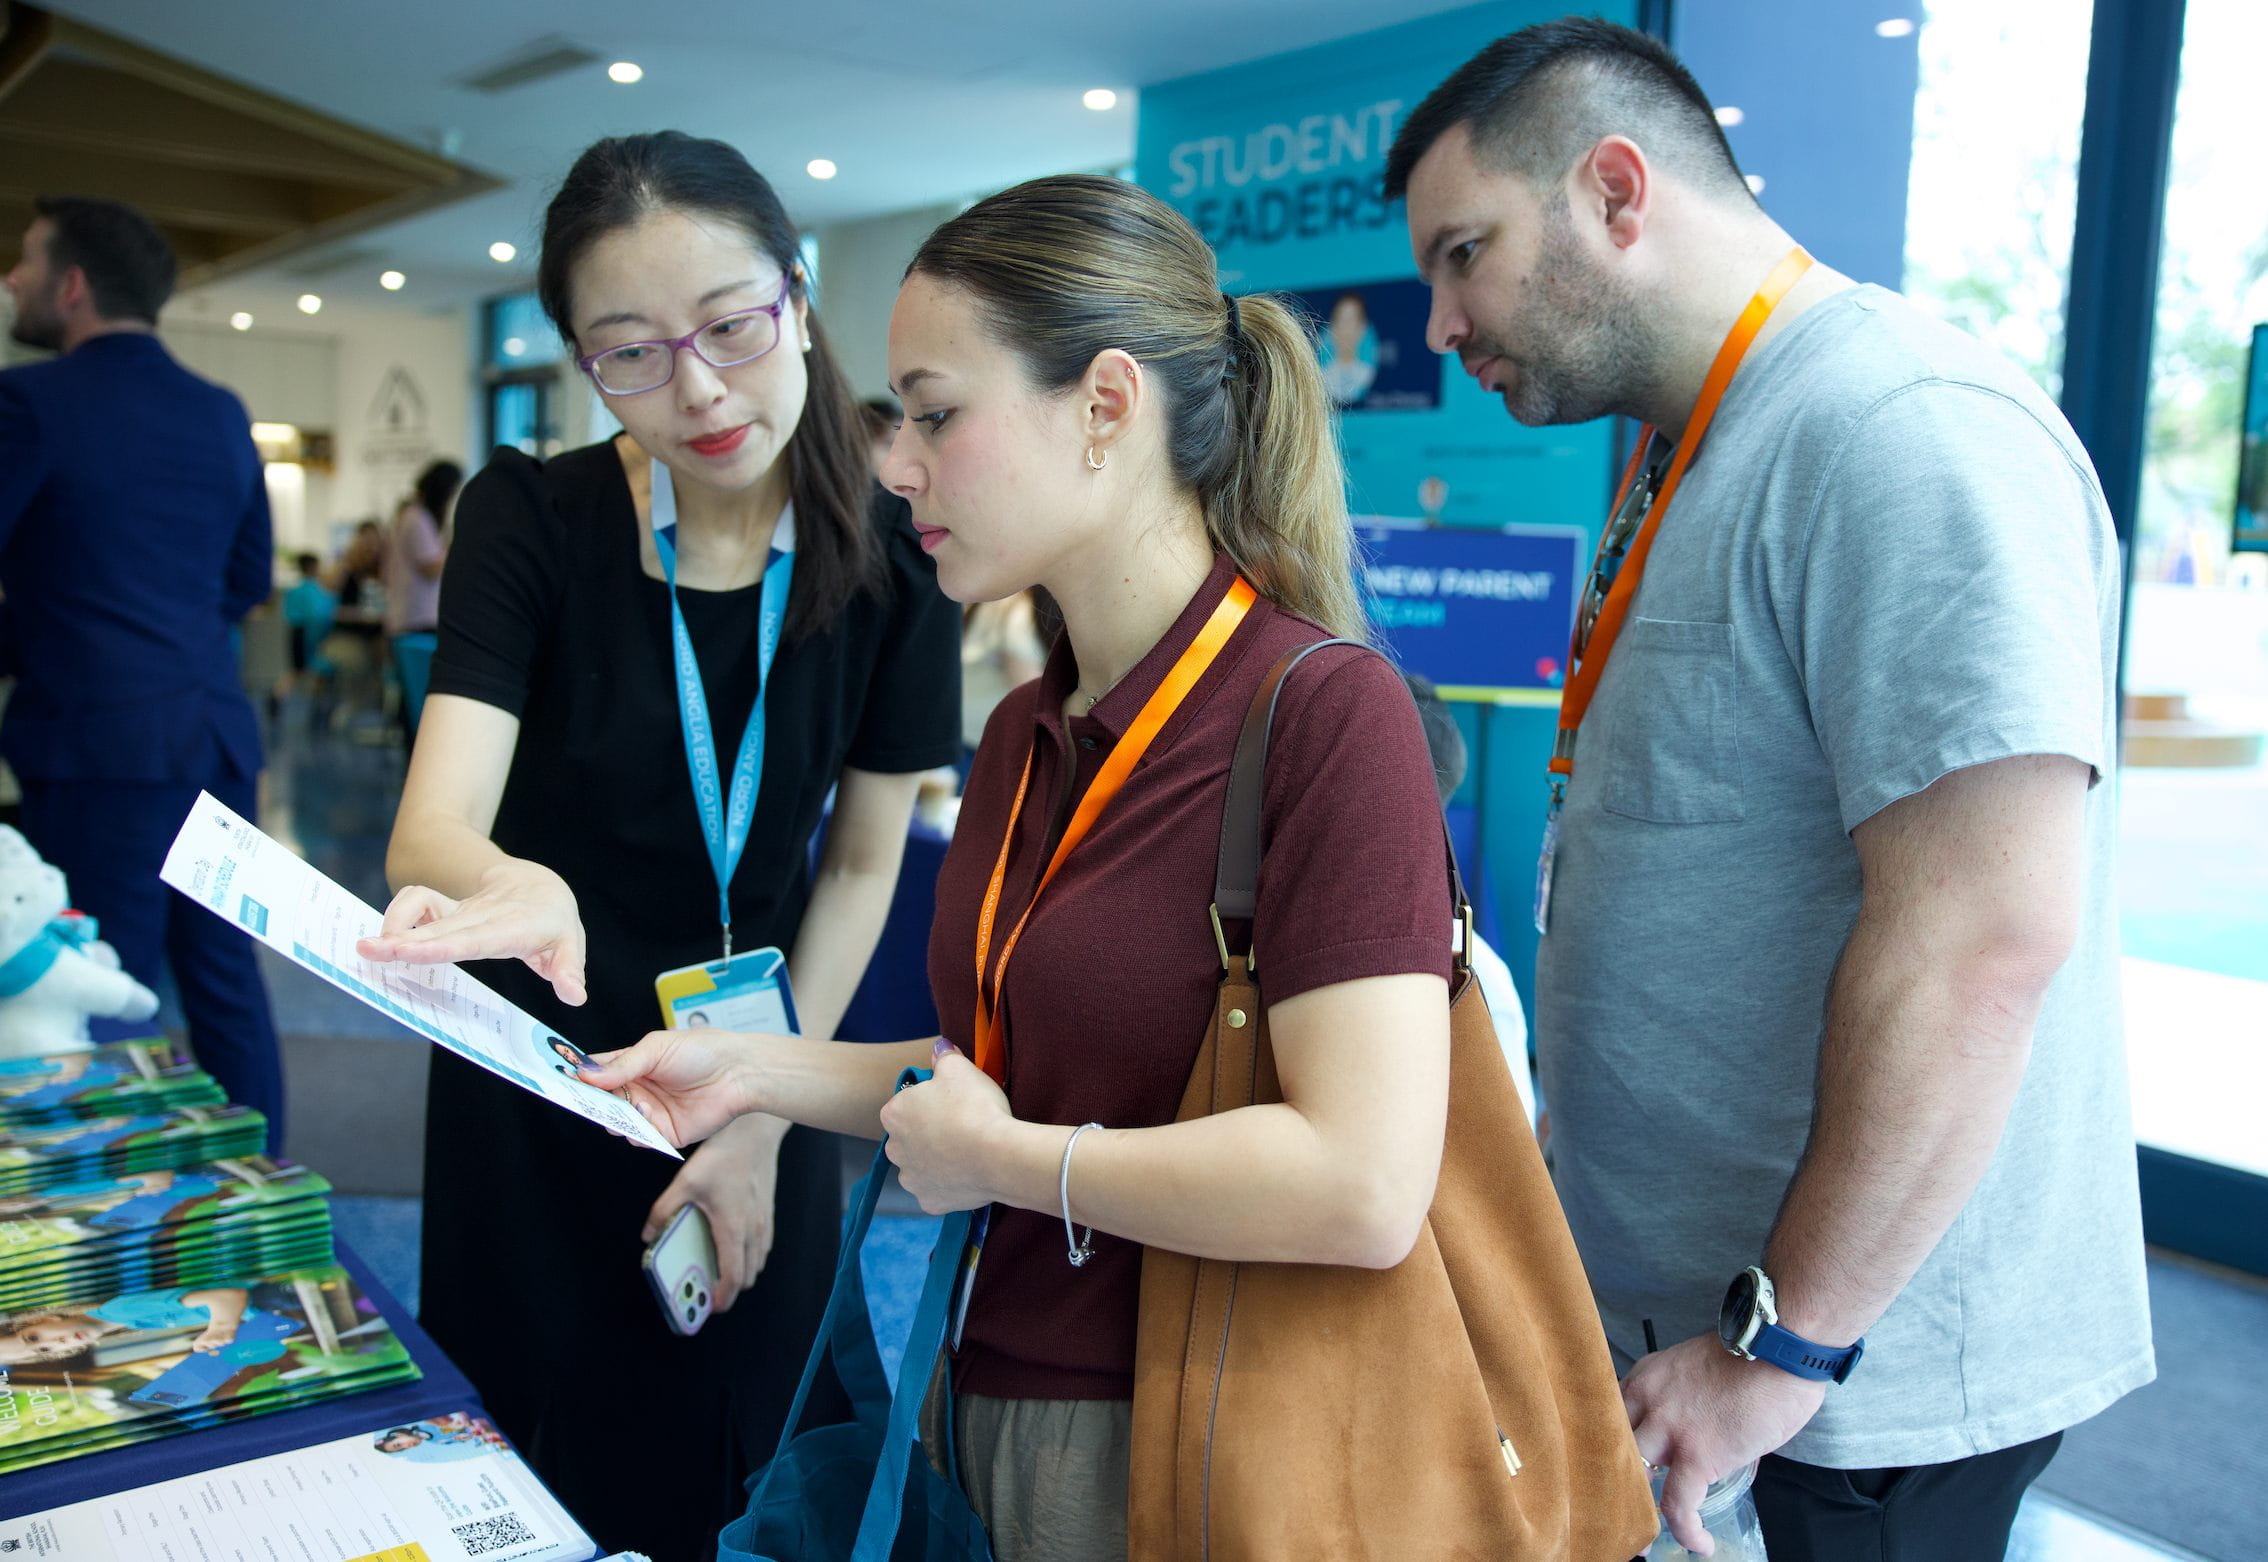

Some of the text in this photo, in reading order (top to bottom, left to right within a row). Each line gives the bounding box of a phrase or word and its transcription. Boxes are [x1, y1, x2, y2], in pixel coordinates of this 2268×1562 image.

[1168, 99, 1403, 198] STUDENT
[1193, 170, 1391, 252] EADERS
[1367, 564, 1554, 602] NEW PARENT
[683, 678, 706, 745] ANGLIA
[692, 746, 720, 845] EDUCATION
[732, 775, 754, 827] NORD
[27, 1386, 58, 1427] GUIDE
